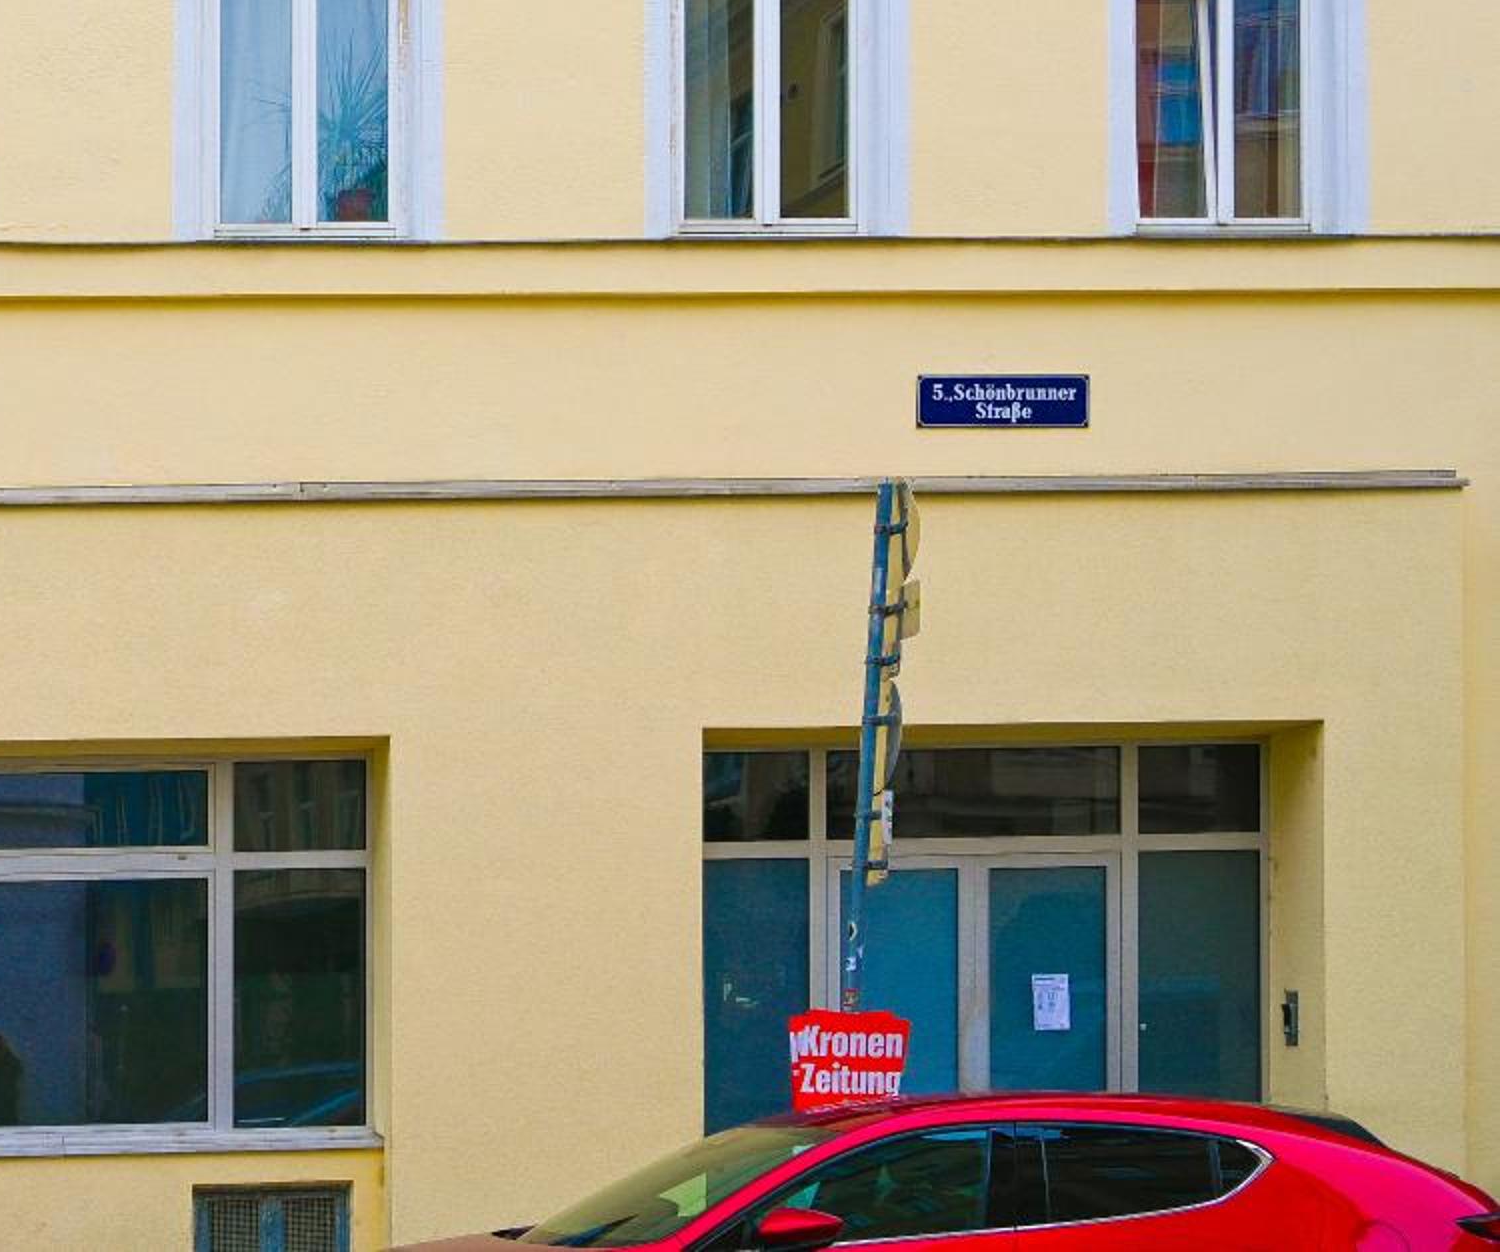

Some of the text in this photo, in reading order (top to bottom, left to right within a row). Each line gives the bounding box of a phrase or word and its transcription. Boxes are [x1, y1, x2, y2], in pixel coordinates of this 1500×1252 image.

[954, 383, 1077, 401] Schönbrunner
[975, 402, 1033, 423] Straße
[799, 1025, 903, 1058] Kronen
[800, 1062, 901, 1096] Zeitung
